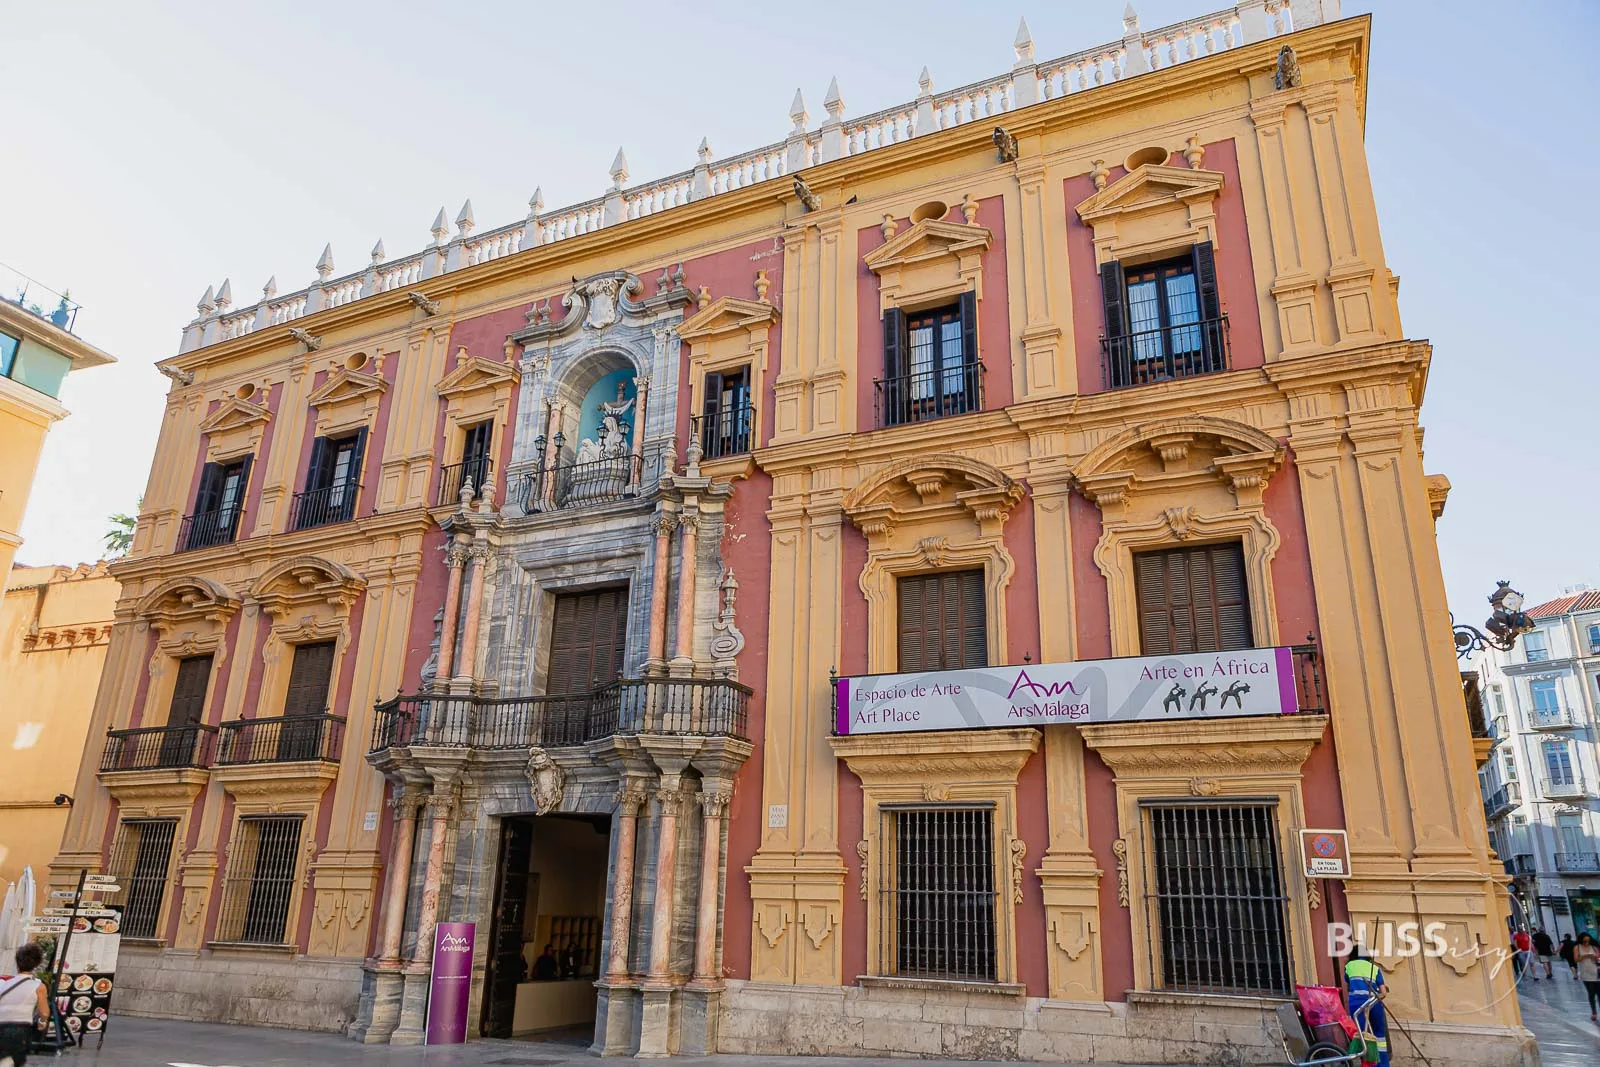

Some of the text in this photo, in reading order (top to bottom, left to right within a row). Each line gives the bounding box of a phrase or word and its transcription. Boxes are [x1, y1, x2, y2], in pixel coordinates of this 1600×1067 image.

[1139, 656, 1269, 681] Arte en África
[855, 682, 961, 703] Espacio de Arte
[855, 707, 921, 724] Art Place
